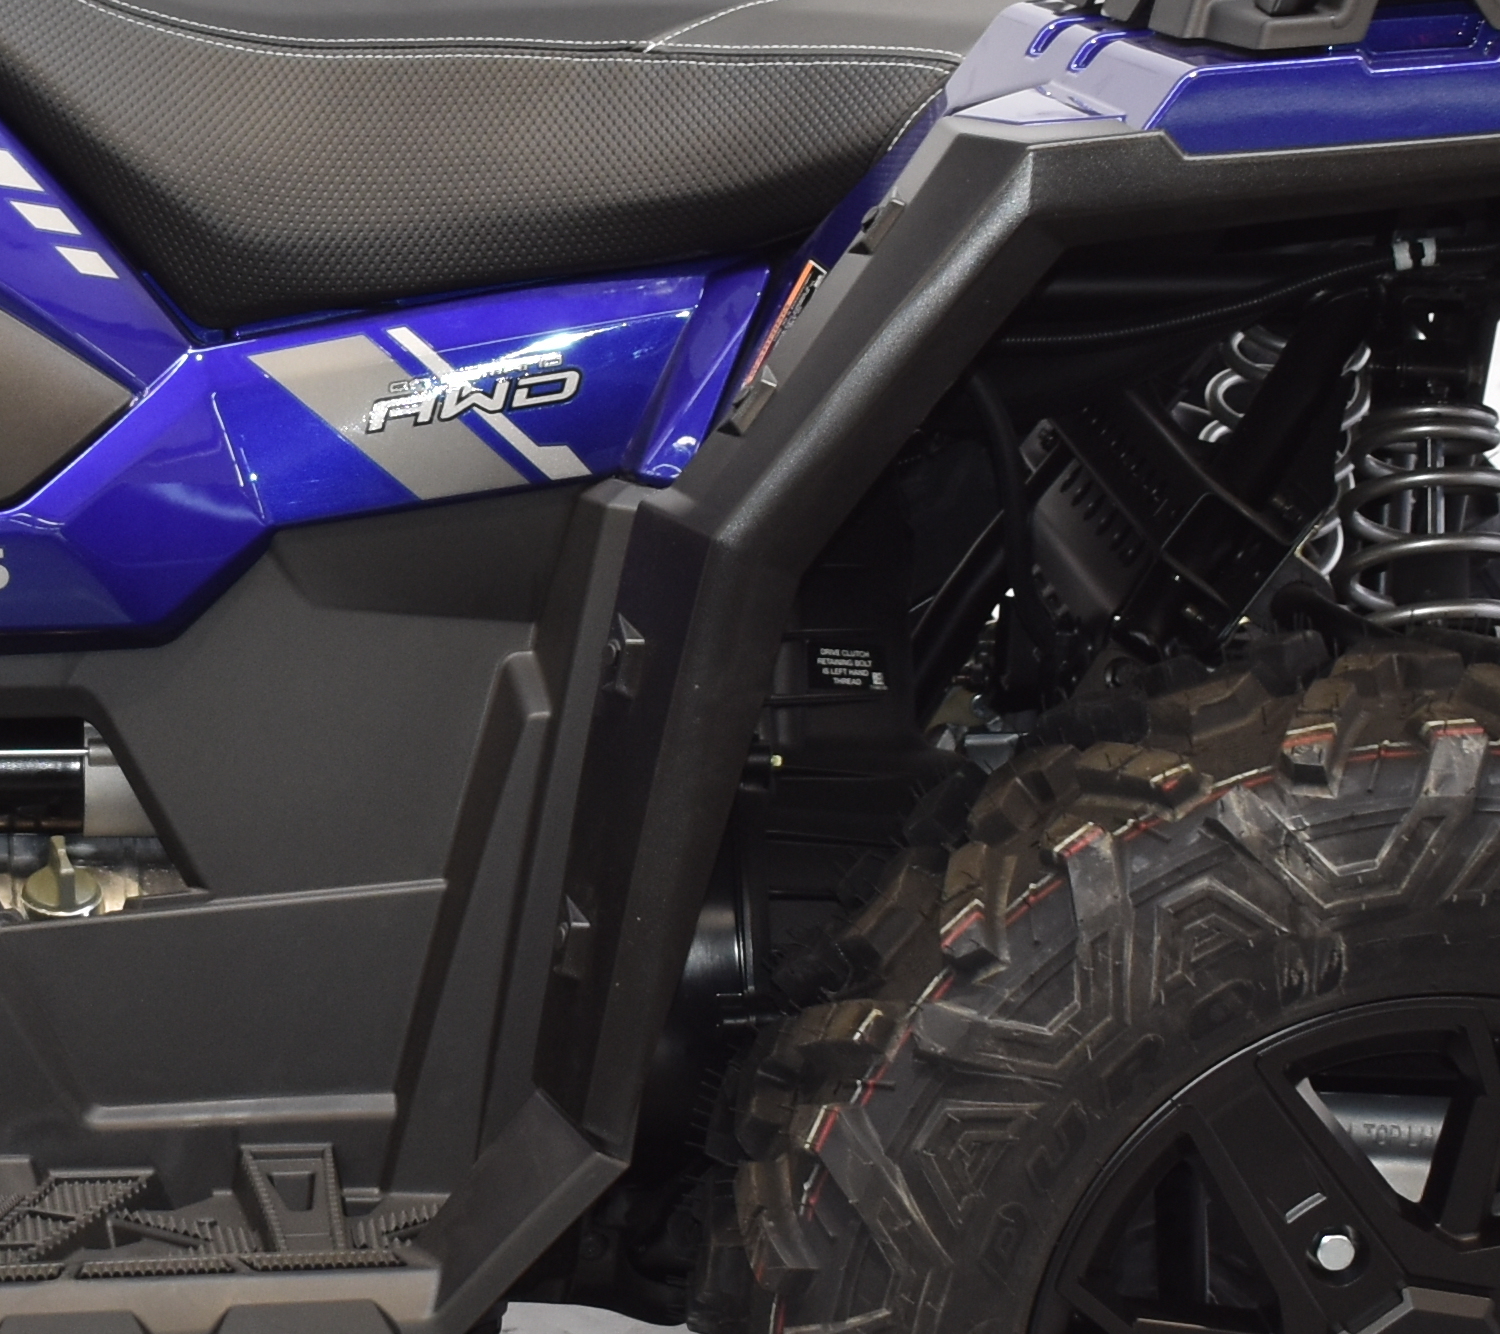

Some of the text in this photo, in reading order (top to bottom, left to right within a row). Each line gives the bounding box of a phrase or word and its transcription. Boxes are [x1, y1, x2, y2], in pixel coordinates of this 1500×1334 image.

[365, 369, 582, 434] AWD
[820, 648, 870, 658] DRIVE CLUTCH
[817, 657, 872, 667] RETAINING BOLT
[822, 667, 870, 677] IS LEFT HAND
[833, 677, 862, 685] THREAD
